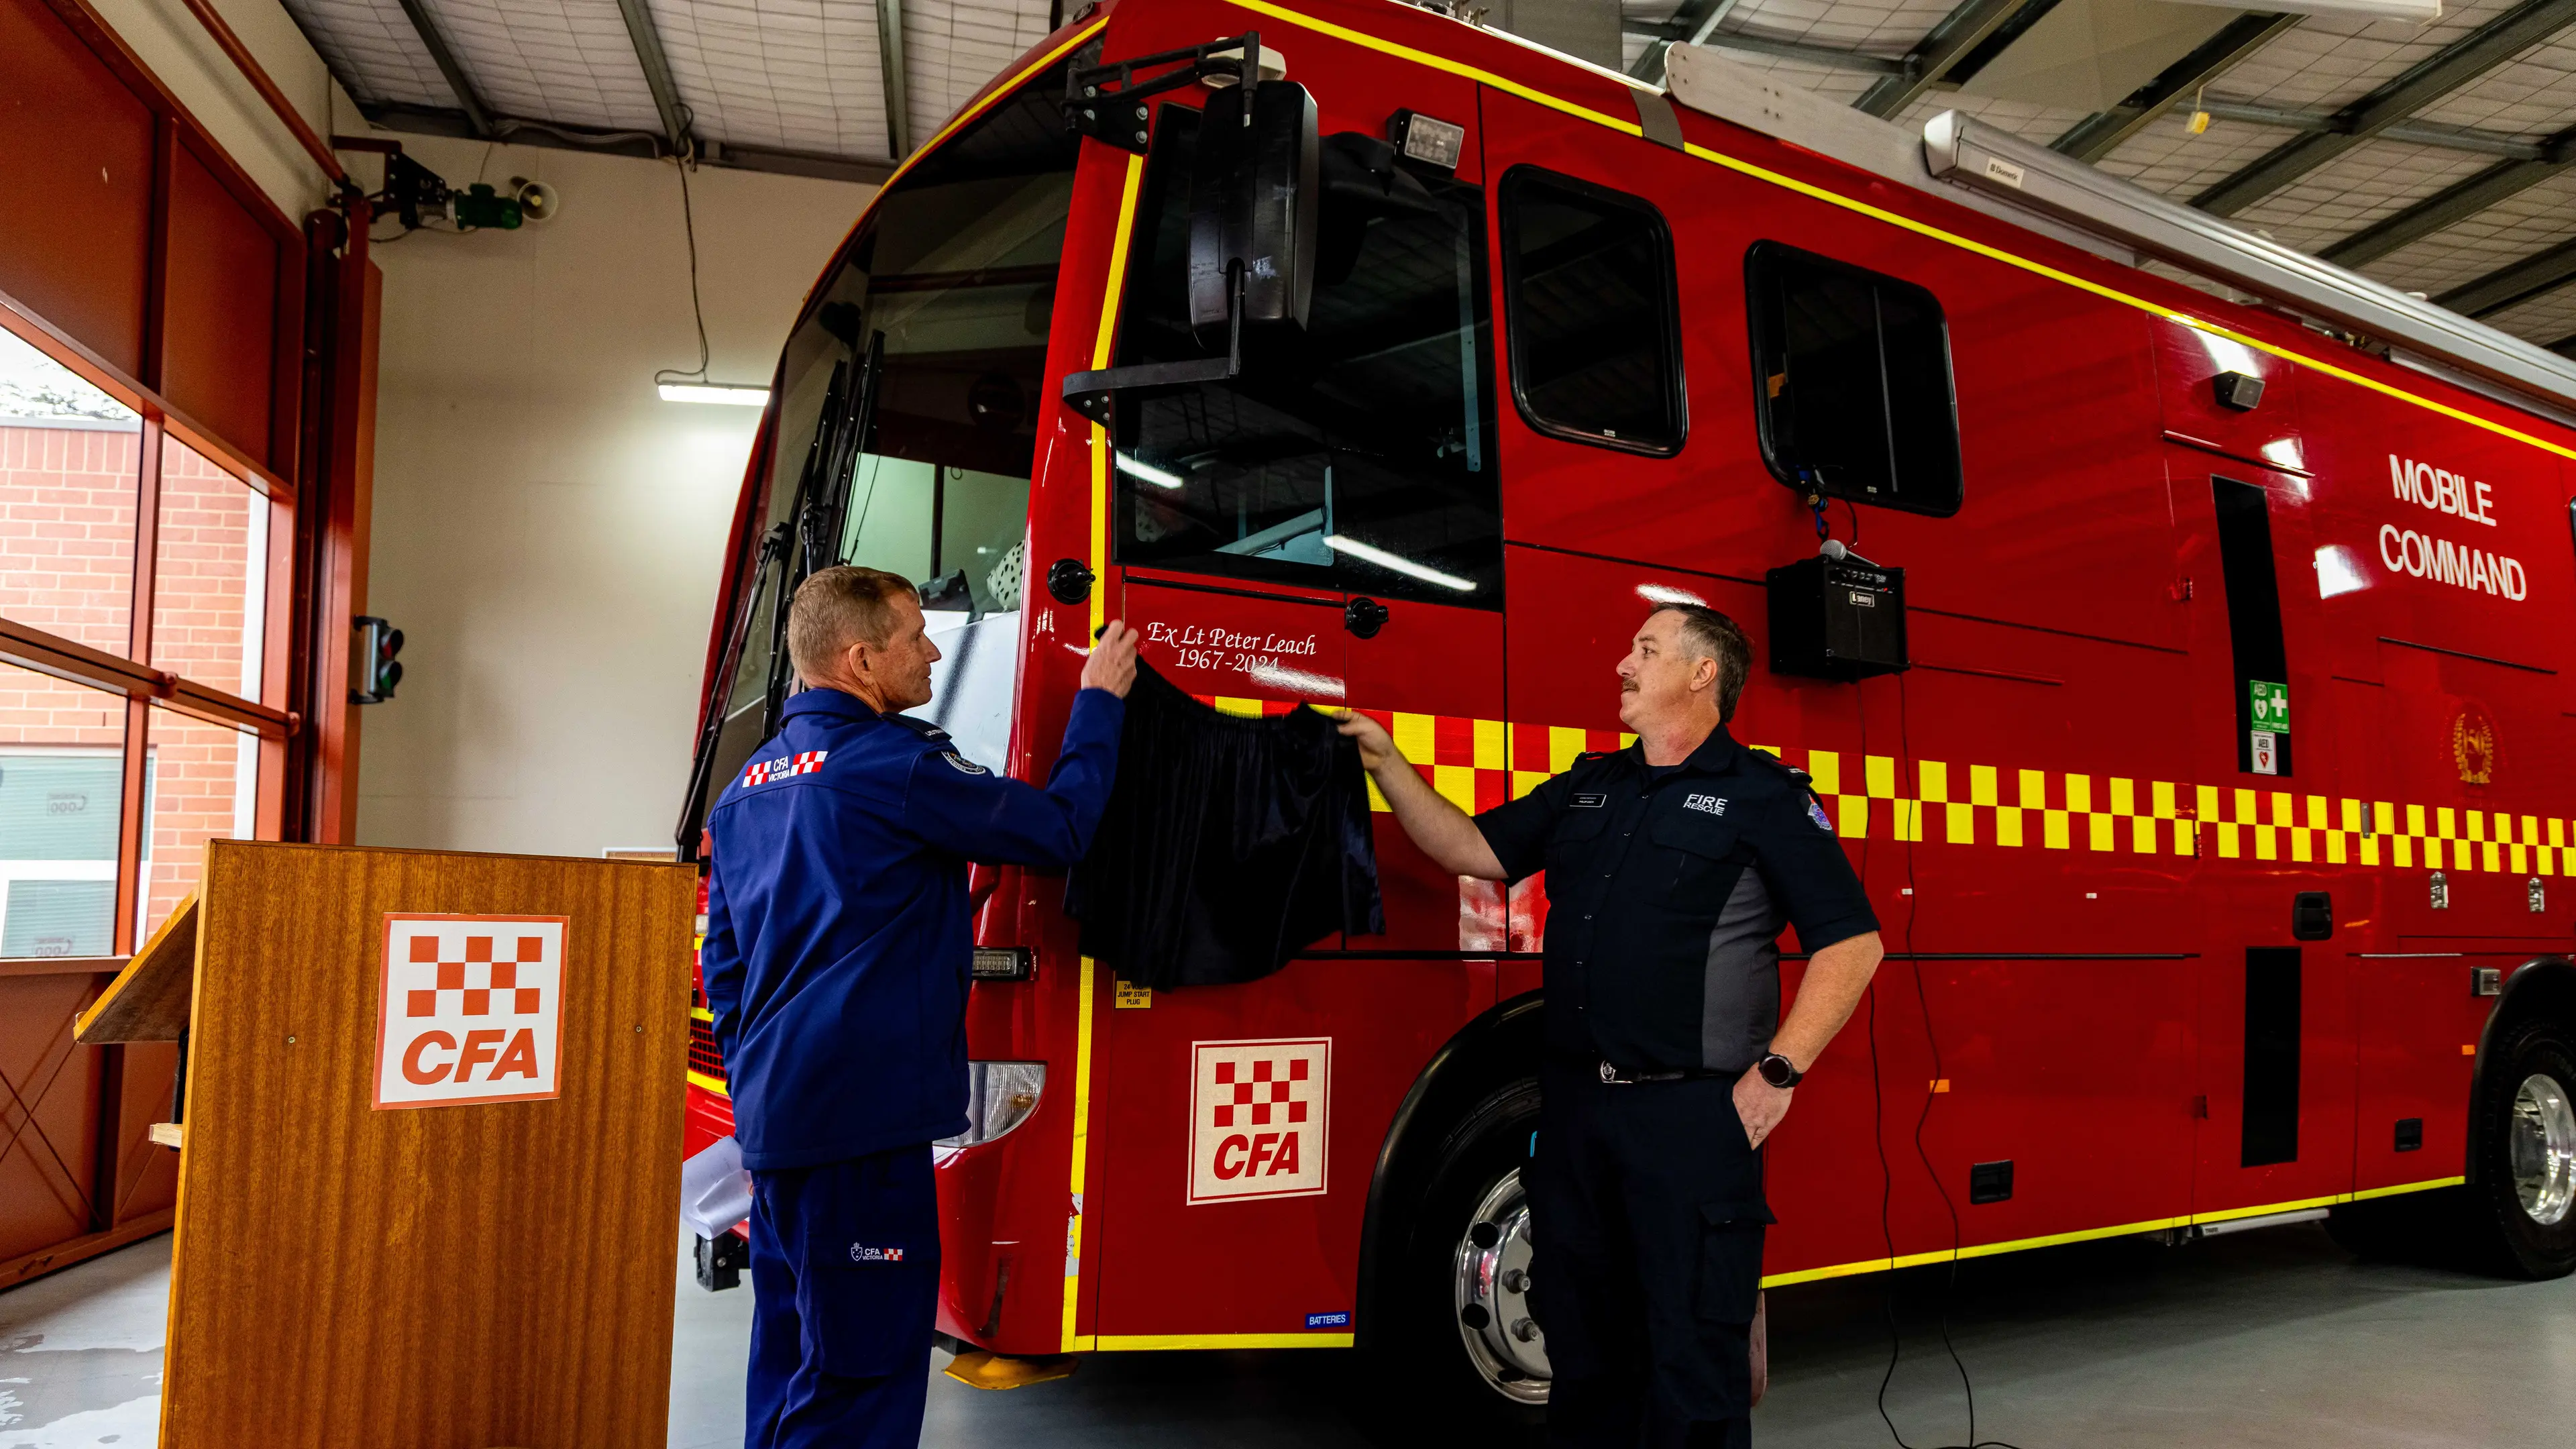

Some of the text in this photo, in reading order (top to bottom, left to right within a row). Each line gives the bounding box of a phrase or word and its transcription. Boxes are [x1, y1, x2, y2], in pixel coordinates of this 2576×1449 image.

[2389, 453, 2497, 527] MOBILE
[2379, 524, 2527, 602] COMMAND
[1852, 593, 1872, 605] Laney
[1147, 622, 1316, 655] Ex Lt Peter Leach
[1175, 648, 1279, 673] 1967-2024
[773, 756, 788, 771] CFA
[768, 769, 790, 782] VICTORIA
[1682, 802, 1724, 816] RESCUE
[1686, 794, 1728, 810] FIRE
[402, 1028, 538, 1085] CFA
[1213, 1131, 1299, 1180] CFA
[1309, 1314, 1346, 1325] BATTERIES
